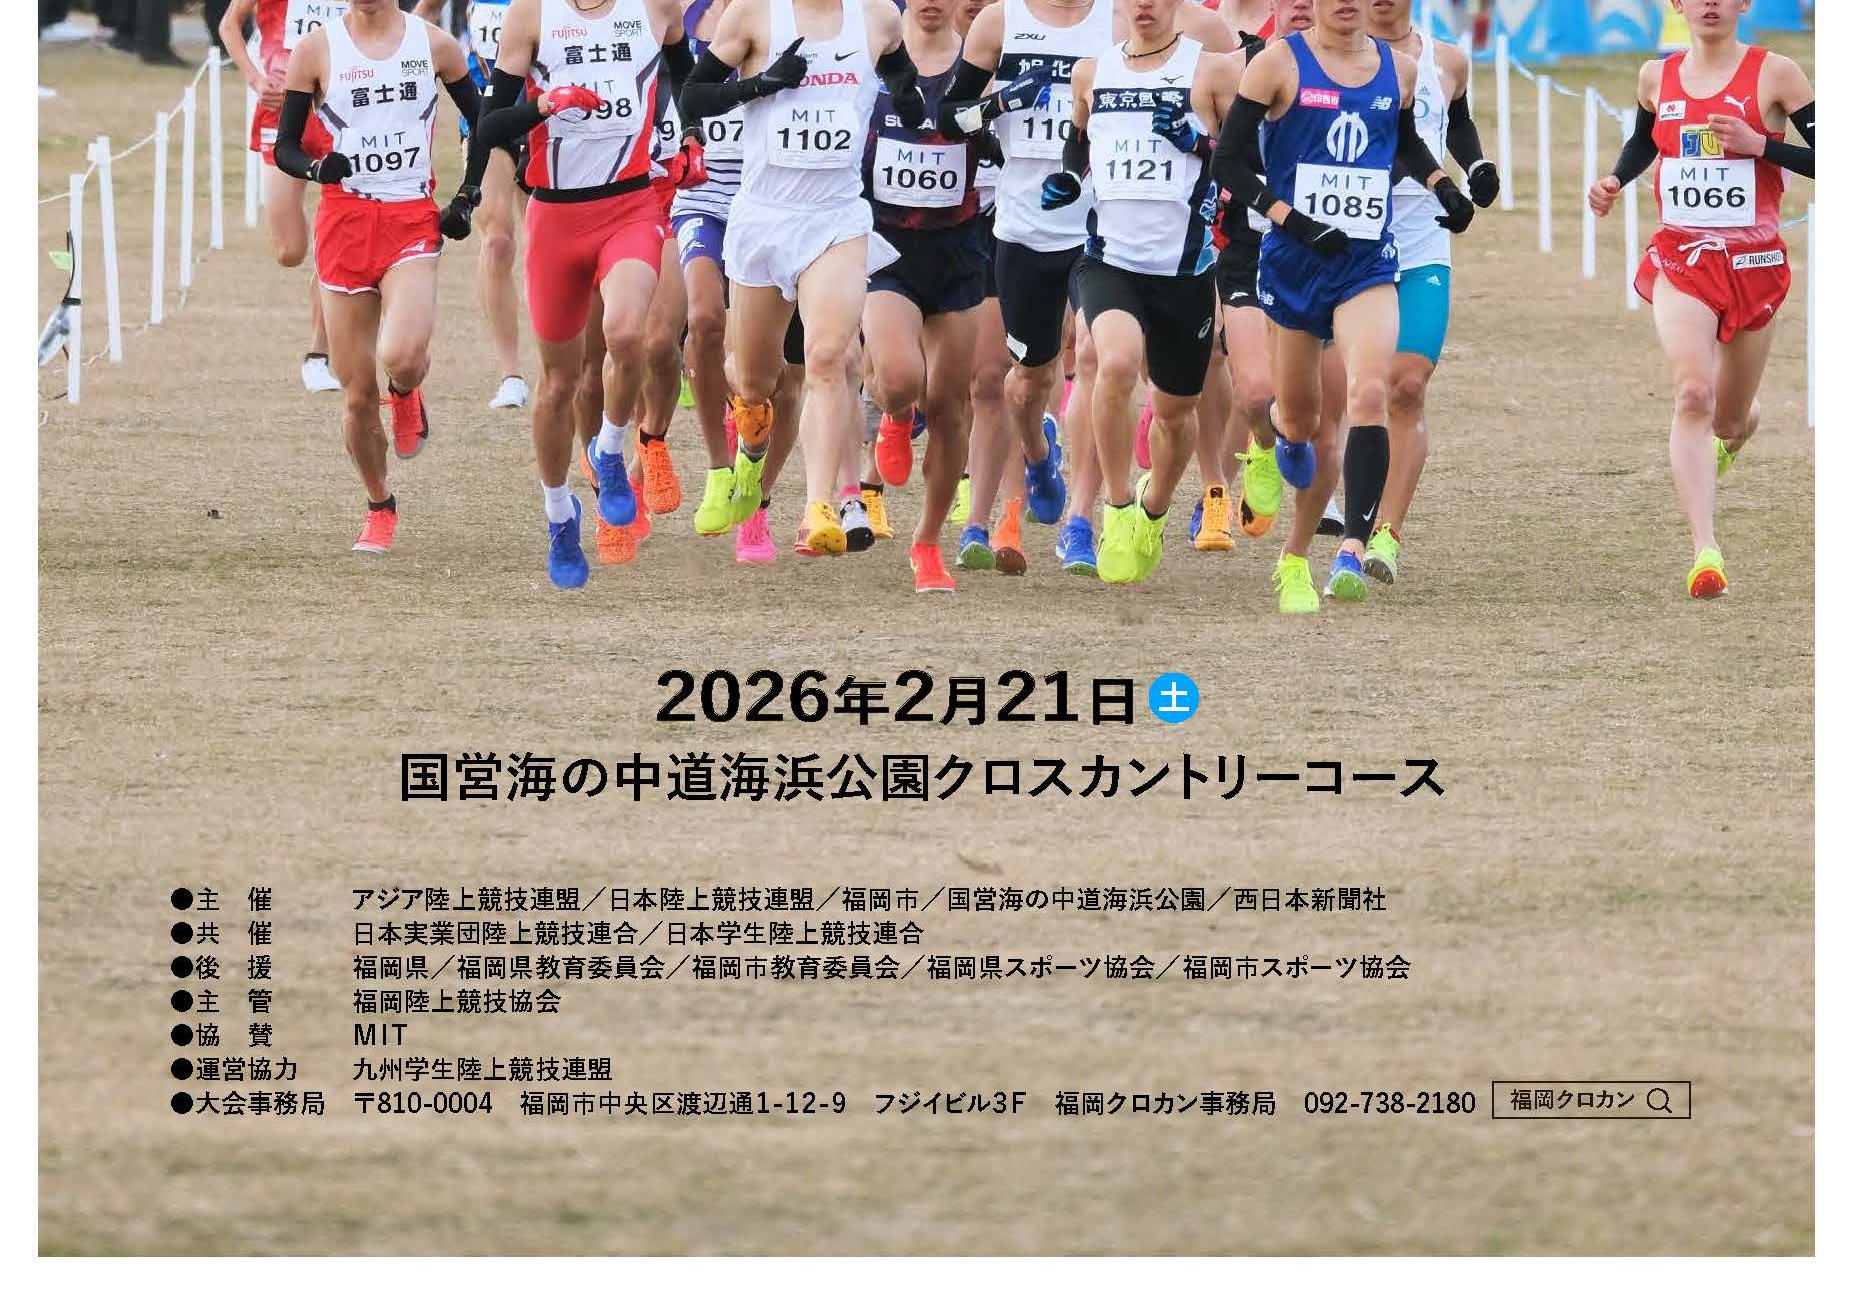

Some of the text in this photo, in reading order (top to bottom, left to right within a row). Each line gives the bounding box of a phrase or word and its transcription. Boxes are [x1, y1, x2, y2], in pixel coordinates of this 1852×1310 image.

[614, 21, 641, 29] MOVE
[564, 42, 632, 66] 富士通
[401, 60, 428, 69] MOVE
[801, 72, 860, 88] ONDA
[351, 81, 418, 108] 富士通
[792, 109, 836, 123] MIT
[1023, 116, 1073, 141] 110
[361, 131, 405, 149] MIT
[777, 127, 851, 151] 1102
[1115, 139, 1162, 153] MIT
[349, 146, 420, 173] 1097
[897, 149, 945, 165] MIT
[882, 165, 958, 190] 1060
[1106, 158, 1173, 181] 1121
[1680, 167, 1731, 182] MIT
[1321, 173, 1373, 190] MIT
[1304, 192, 1385, 220] 1085
[1668, 185, 1746, 209] 1066
